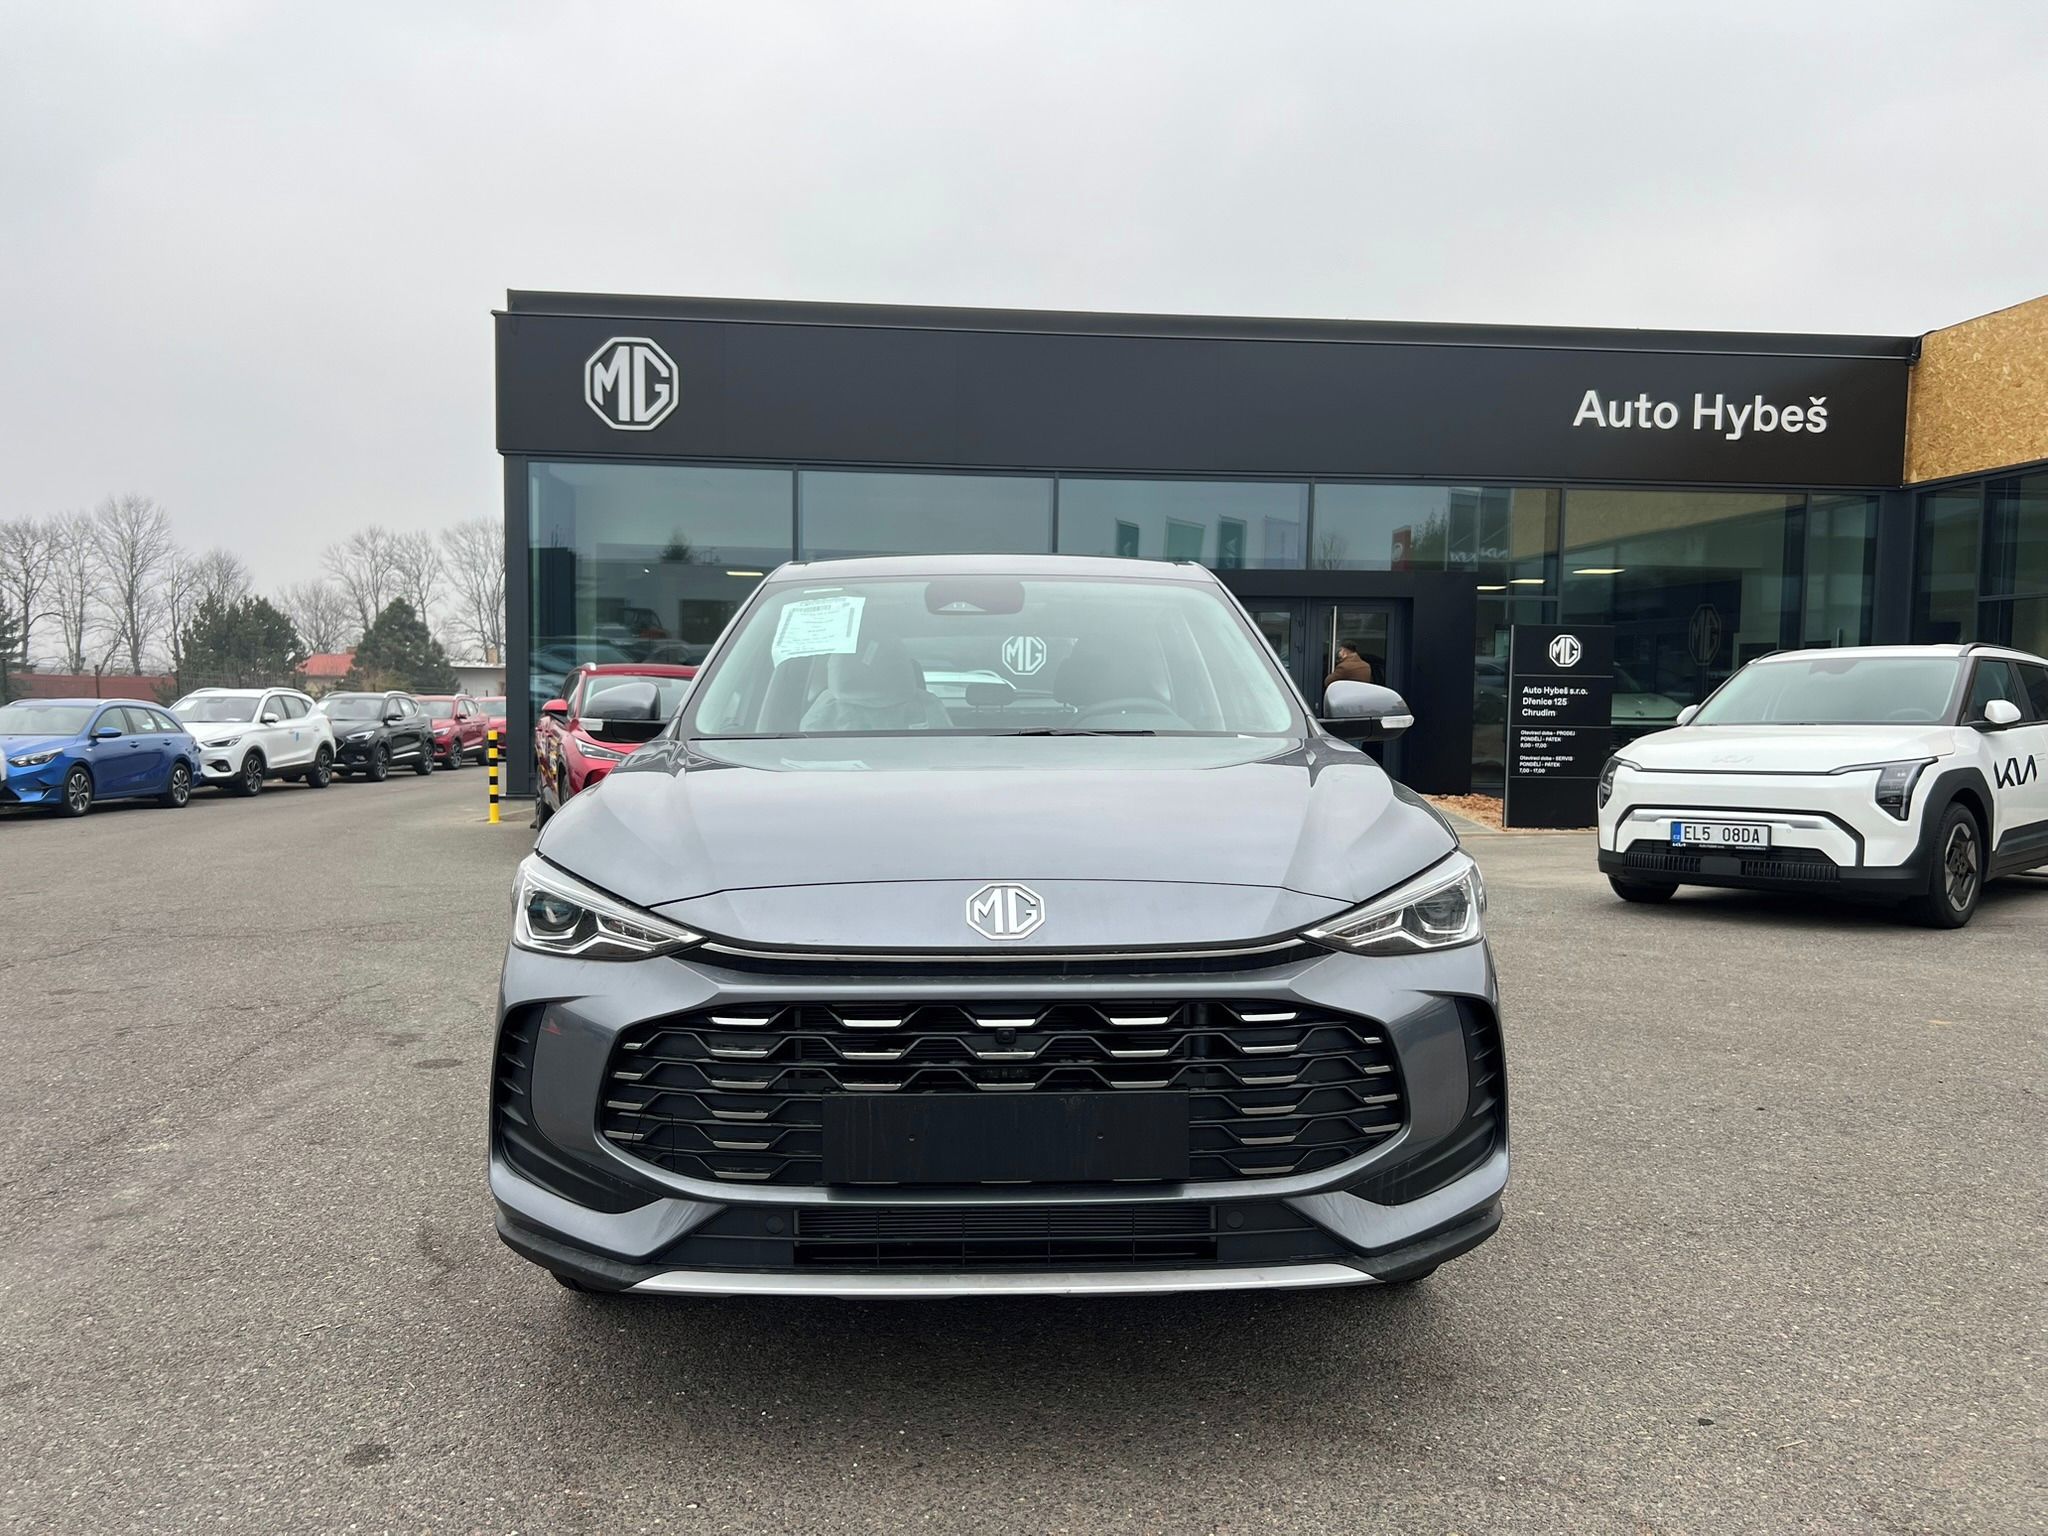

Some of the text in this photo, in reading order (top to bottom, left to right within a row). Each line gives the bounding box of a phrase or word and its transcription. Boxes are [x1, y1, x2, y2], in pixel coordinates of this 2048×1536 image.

[592, 345, 671, 423] MG
[1572, 389, 1828, 441] Auto Hybeš
[1005, 635, 1044, 672] MG
[1552, 637, 1578, 664] MG
[1522, 686, 1542, 694] Auto
[1543, 686, 1568, 696] Hybeš
[1522, 697, 1567, 706] Dřenice 125
[1522, 708, 1556, 717] Chrudim
[1993, 754, 2037, 789] KIA
[1684, 825, 1760, 843] EL5 08DA
[972, 887, 1039, 934] MG
